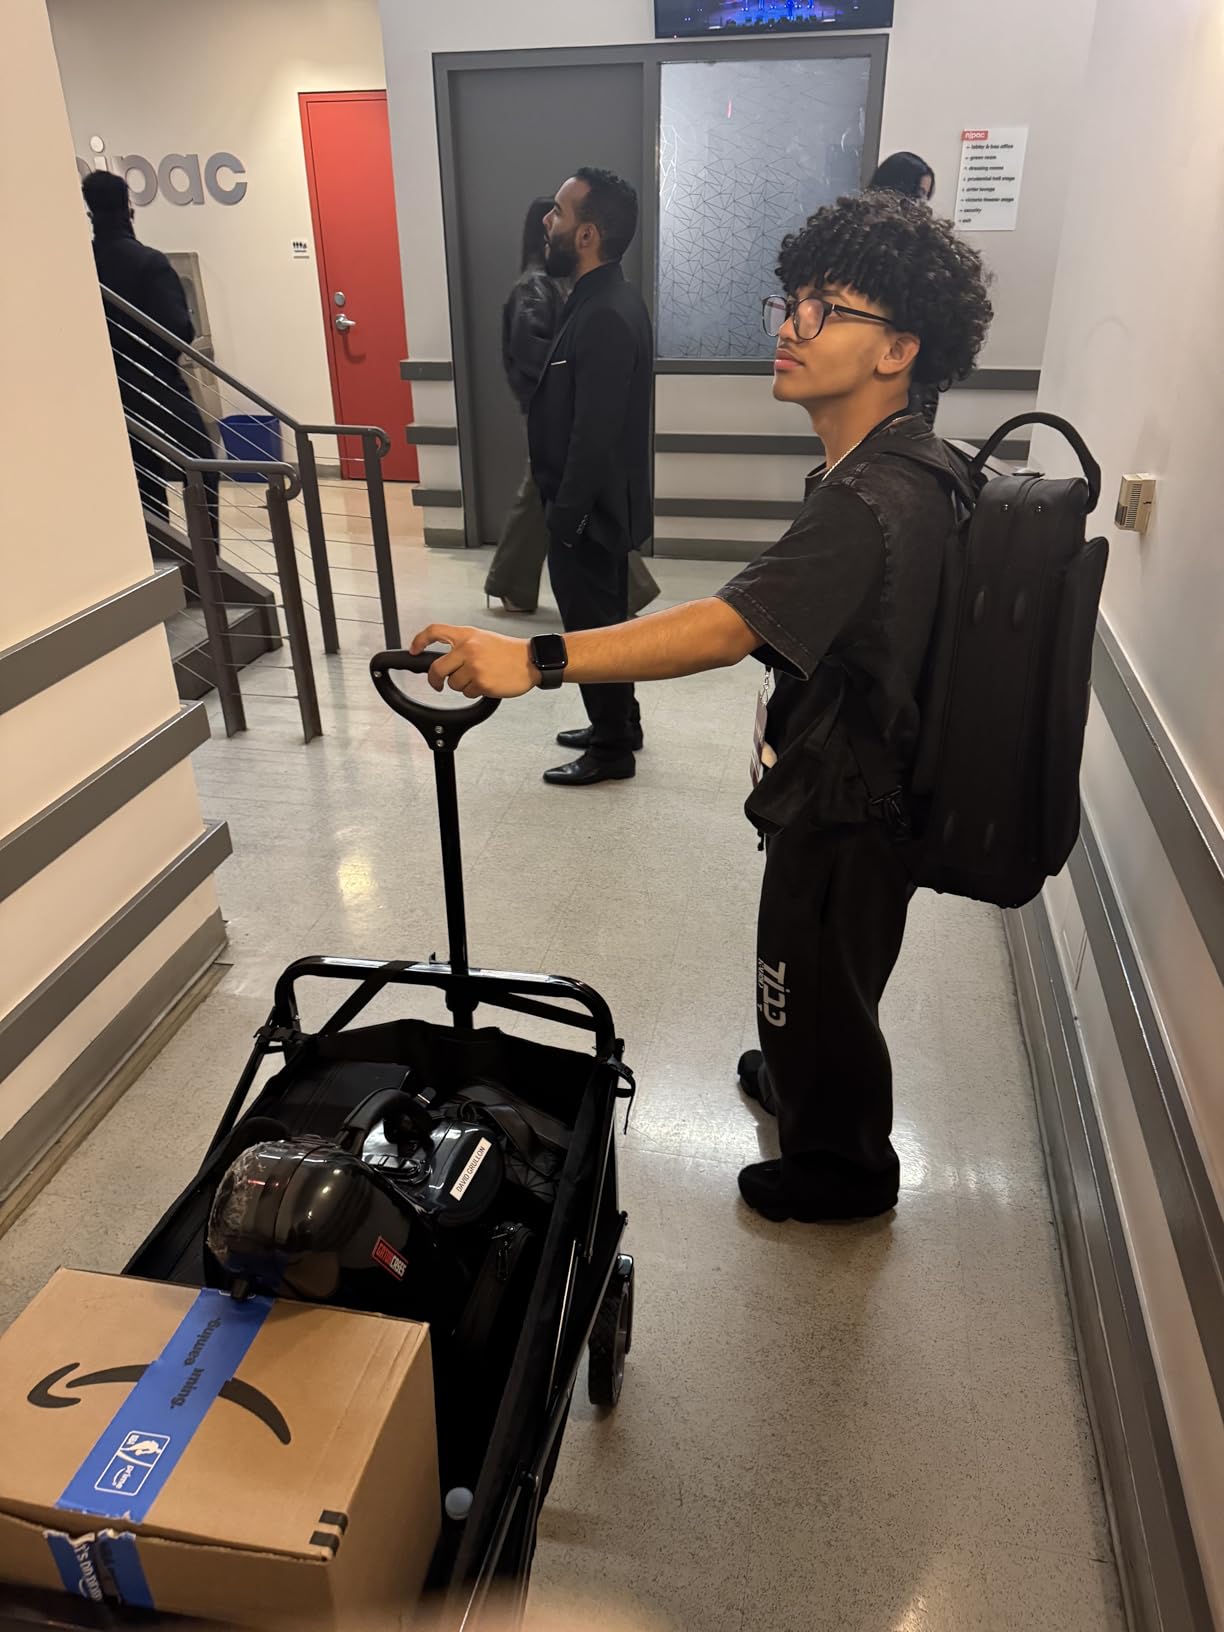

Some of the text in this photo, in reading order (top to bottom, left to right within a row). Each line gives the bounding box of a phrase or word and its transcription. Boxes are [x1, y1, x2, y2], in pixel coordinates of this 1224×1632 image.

[76, 135, 248, 206] pac
[456, 1146, 486, 1192] DAVID GRULLON
